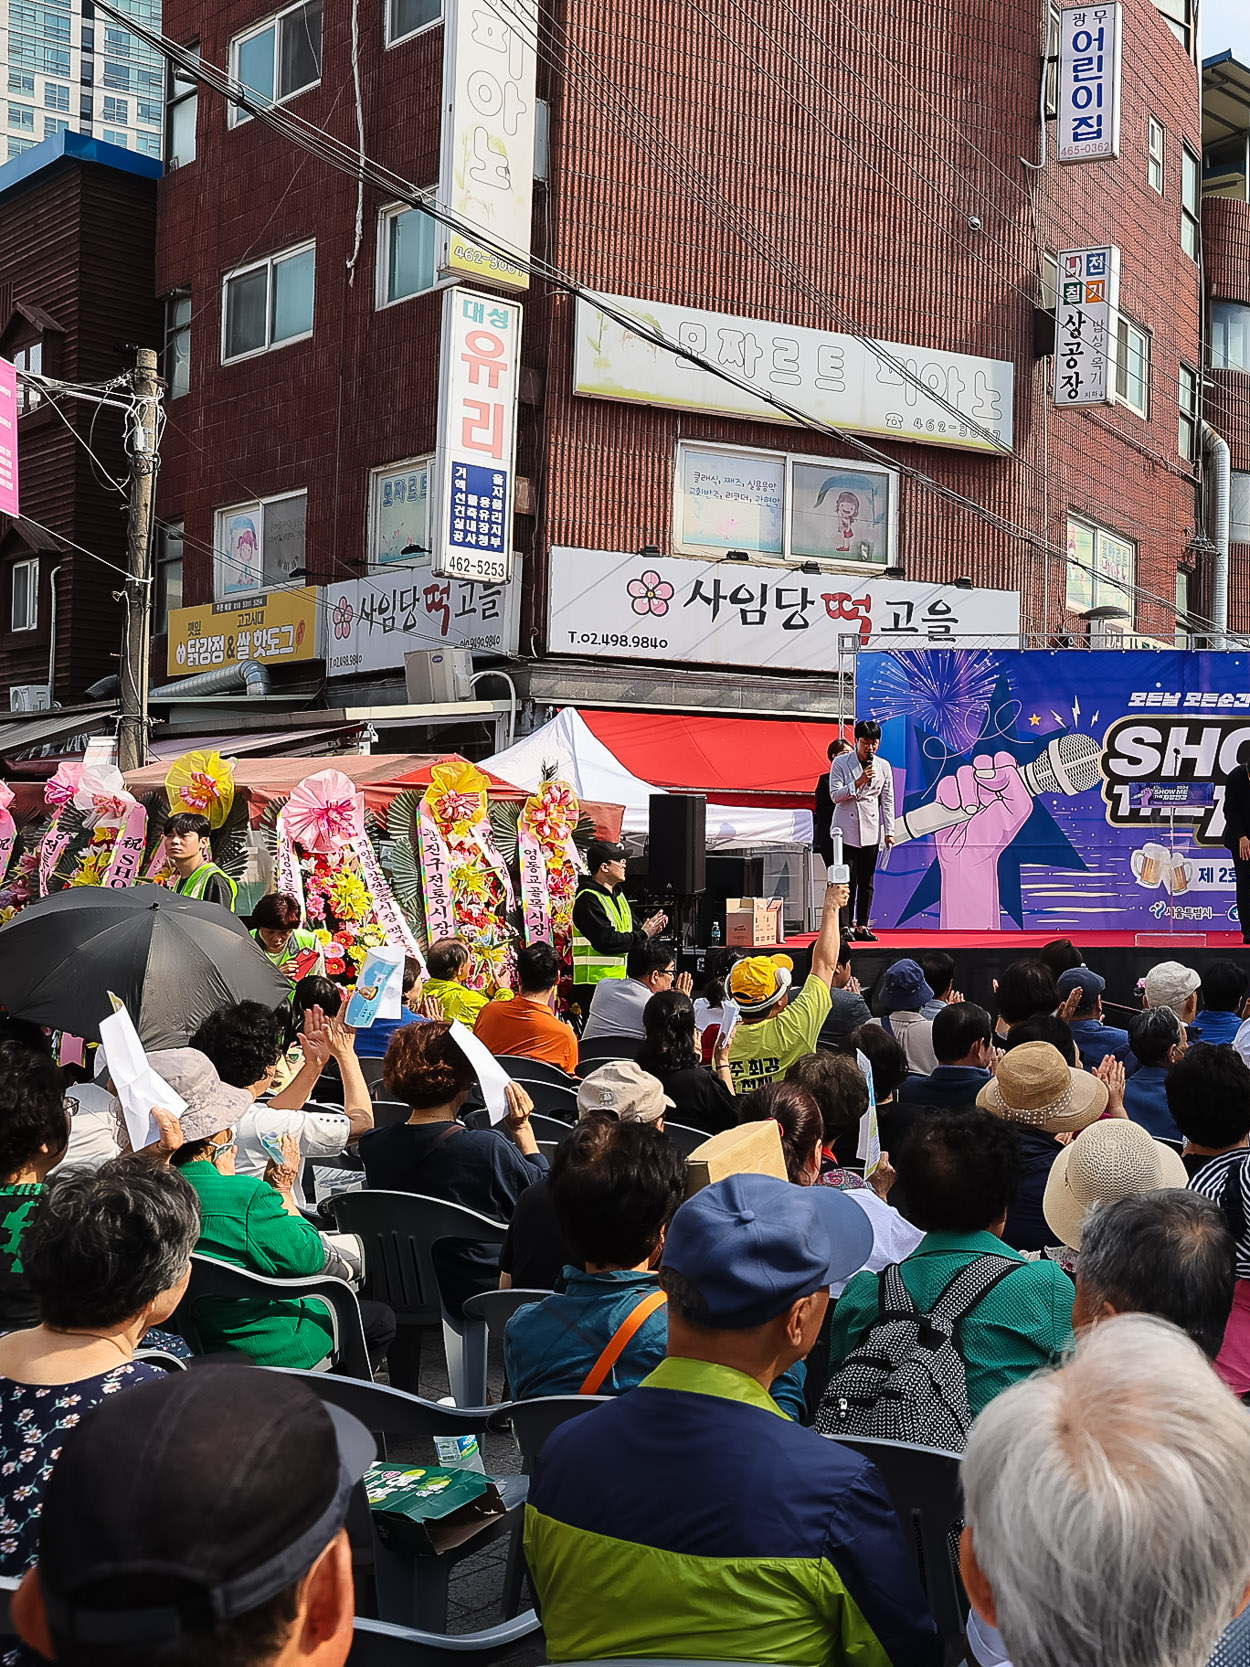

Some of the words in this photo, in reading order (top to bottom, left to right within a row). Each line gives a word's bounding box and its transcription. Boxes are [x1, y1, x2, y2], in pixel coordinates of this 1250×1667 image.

[1072, 9, 1108, 27] 광무
[1071, 26, 1105, 143] 어린이집
[1061, 142, 1110, 157] 465-0362
[1065, 283, 1105, 303] 칠기
[463, 299, 510, 329] 대성
[1060, 311, 1087, 400] 상공장
[675, 321, 846, 392] 모짜르트
[876, 353, 1003, 421] 피아노
[461, 330, 508, 460] 유리
[693, 471, 721, 486] 클래식,
[449, 556, 505, 578] 462-5253
[356, 585, 421, 637] 사임당
[423, 580, 450, 637] 떡
[683, 578, 815, 631] 사임당
[821, 591, 872, 646] 떡
[879, 598, 960, 642] 고을
[187, 634, 225, 667] 닭강정
[226, 635, 235, 659] &
[236, 630, 251, 660] 쌀
[253, 624, 294, 658] 핫도그
[1128, 692, 1182, 708] 모든날
[122, 837, 142, 851] 祝
[422, 828, 452, 936] 광진구전통시장
[1198, 867, 1215, 884] 제
[524, 849, 549, 937] 영동교골목시장
[1164, 906, 1213, 920] 서울특별시
[749, 1057, 780, 1076] 최강
